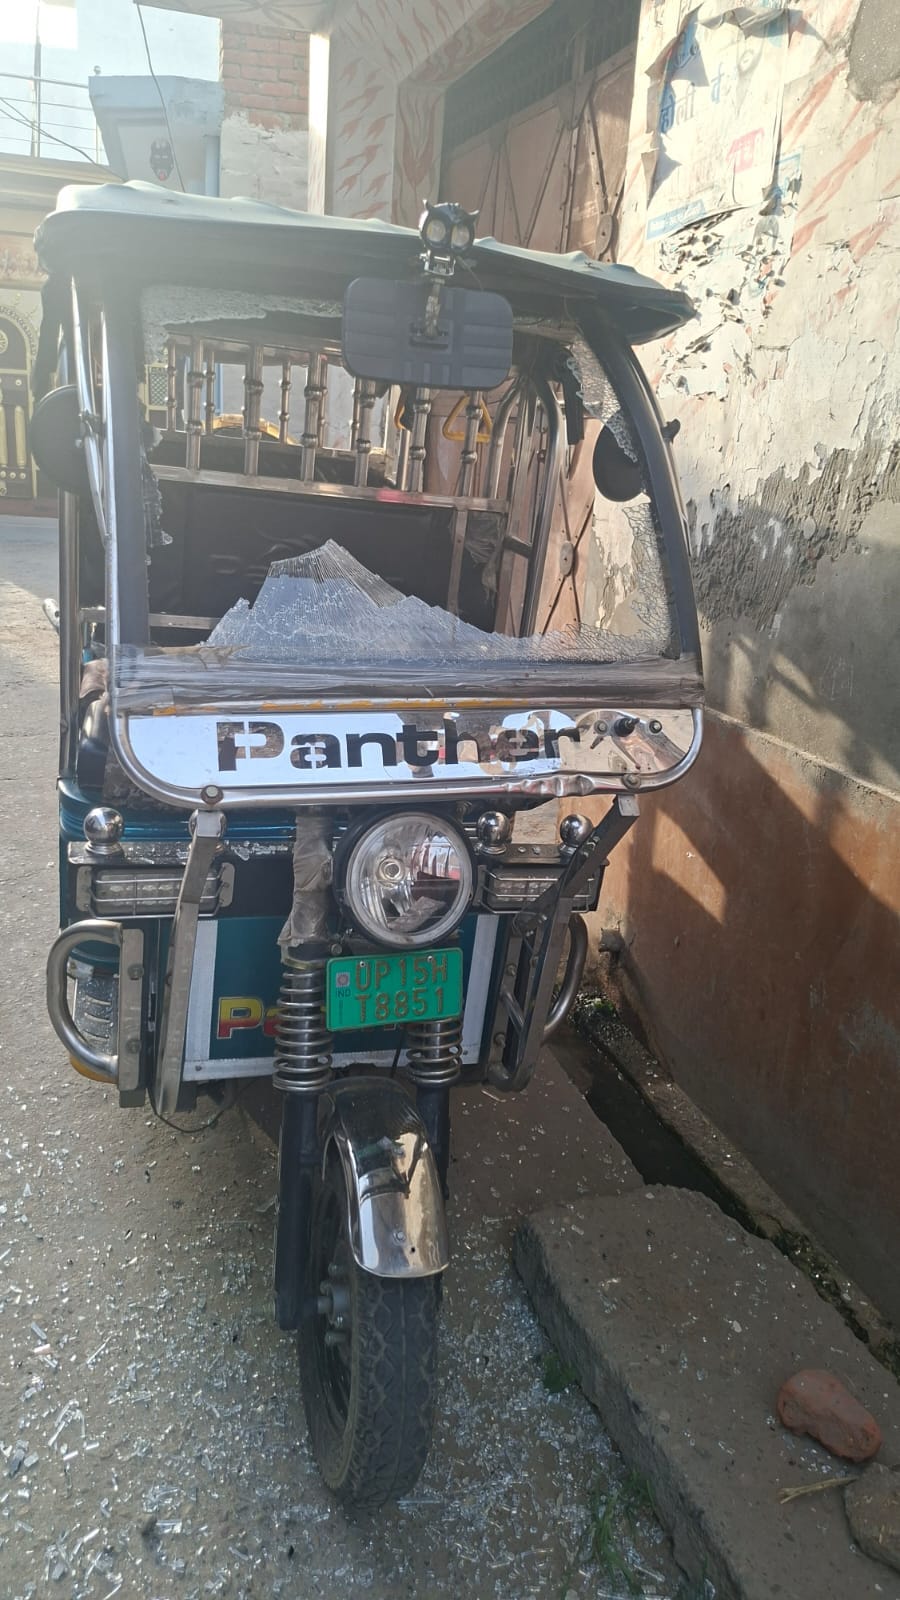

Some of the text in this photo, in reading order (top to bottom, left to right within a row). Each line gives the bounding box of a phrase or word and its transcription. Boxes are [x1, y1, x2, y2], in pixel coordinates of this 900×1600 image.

[216, 715, 581, 772] Panther
[335, 988, 352, 998] IND
[356, 986, 445, 1023] T8851
